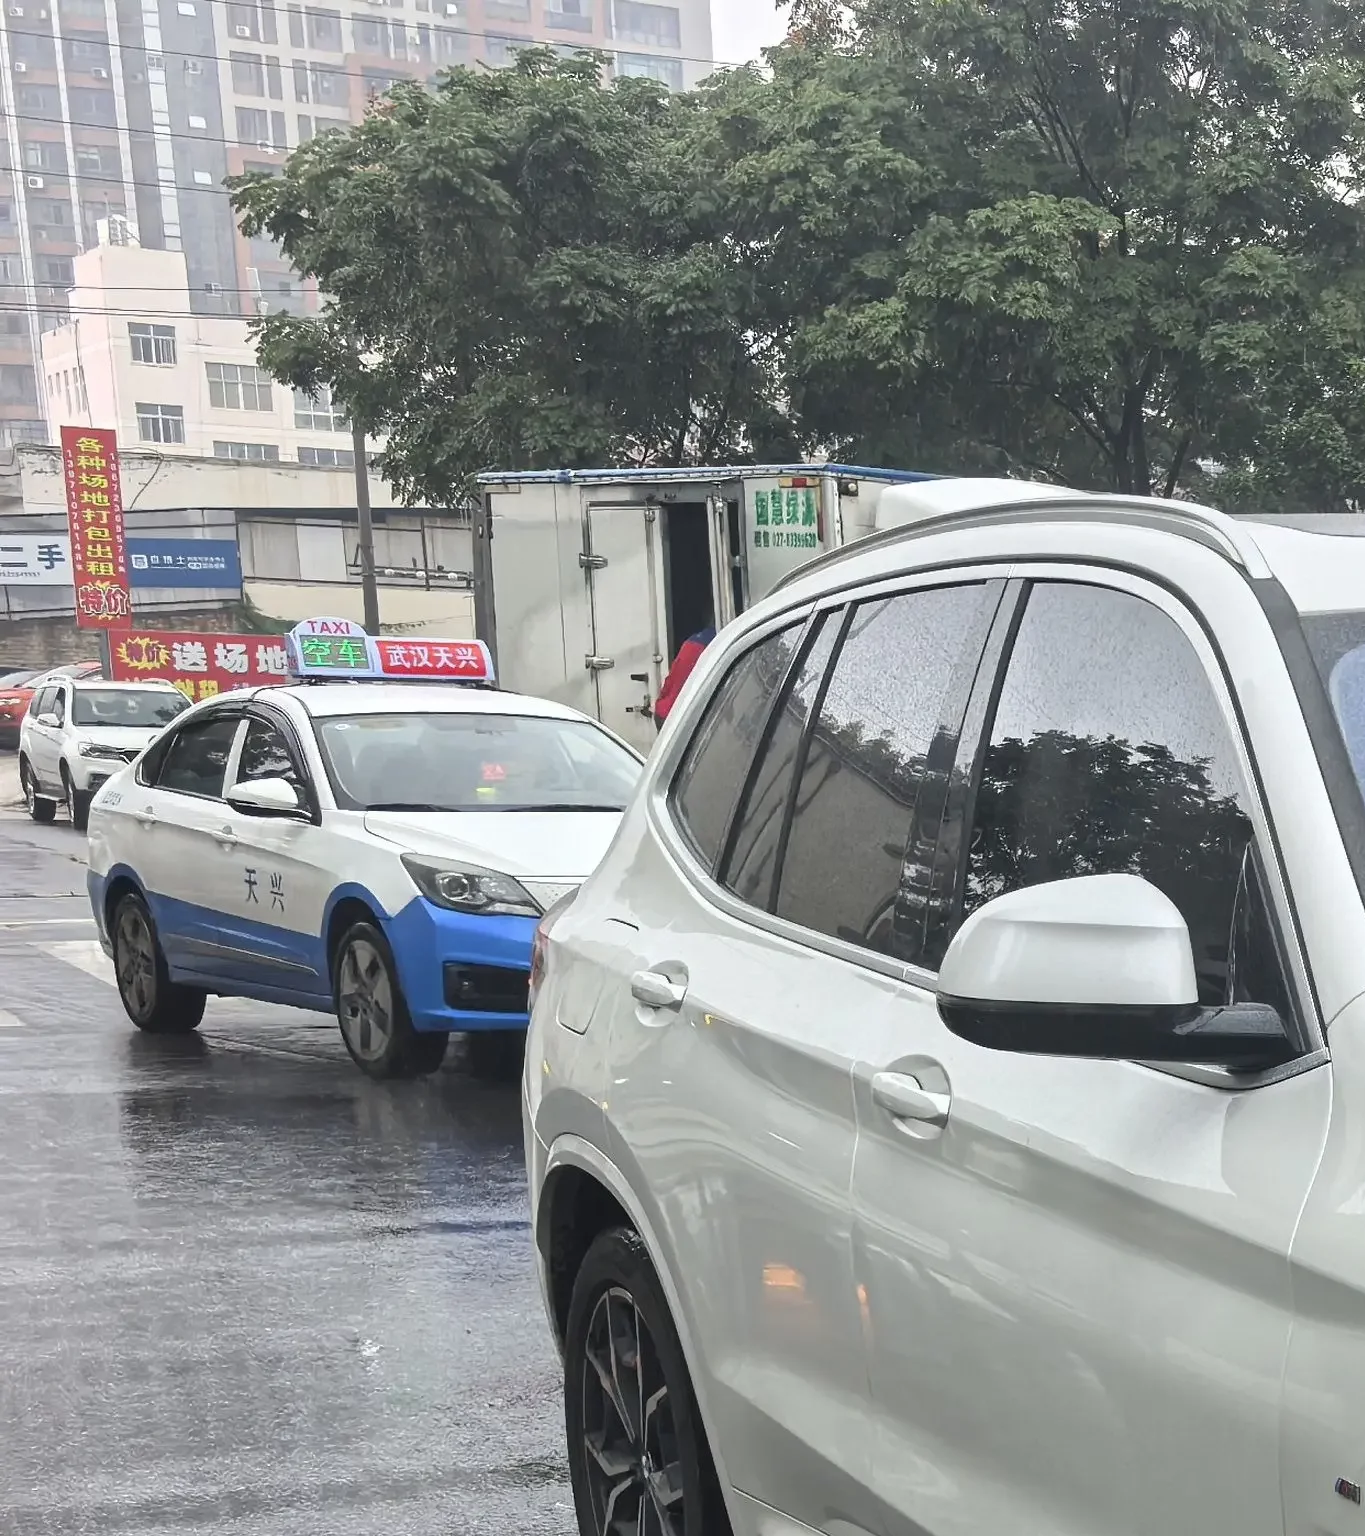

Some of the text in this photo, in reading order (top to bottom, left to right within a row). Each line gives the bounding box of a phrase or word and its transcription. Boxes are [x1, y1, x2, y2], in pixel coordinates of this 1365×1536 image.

[76, 437, 116, 576] 各种场地打包出租
[79, 585, 128, 614] 特价
[307, 620, 351, 635] TAXI
[302, 638, 367, 668] 空车
[385, 644, 479, 670] 武汉天兴
[244, 866, 286, 914] 天兴
